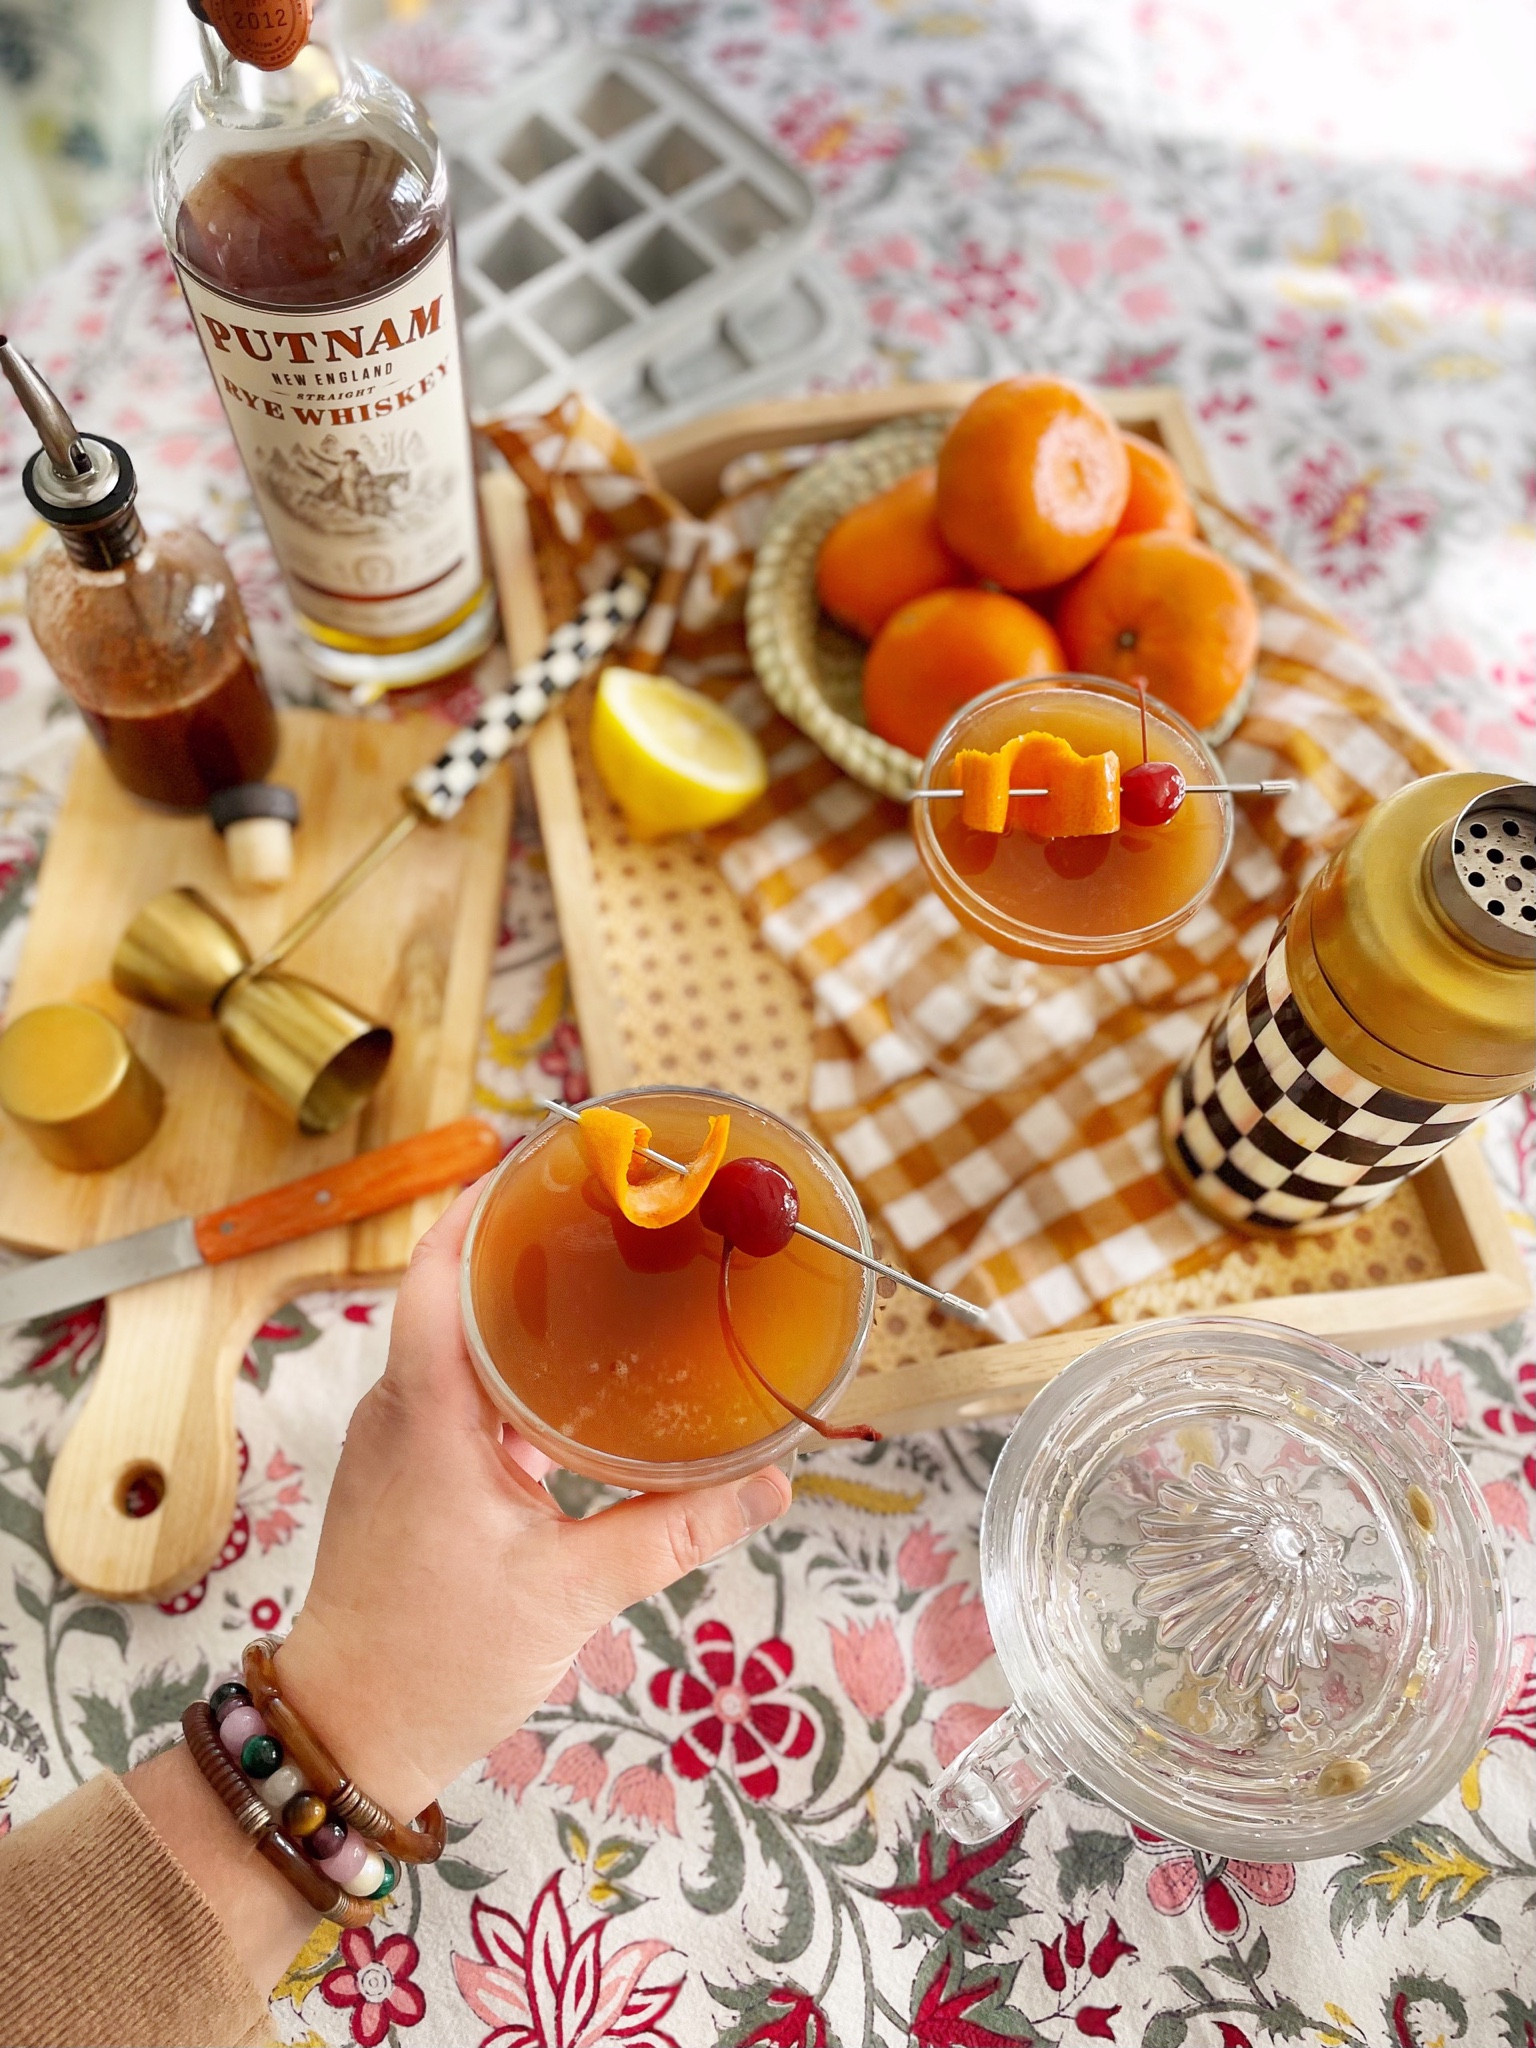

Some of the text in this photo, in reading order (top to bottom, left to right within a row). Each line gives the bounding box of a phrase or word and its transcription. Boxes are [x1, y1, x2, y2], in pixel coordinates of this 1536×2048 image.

[233, 8, 288, 30] 2012
[200, 294, 443, 364] PUTNAM
[271, 362, 394, 387] NEW ENGLAND
[222, 353, 450, 426] RYE WHISKEY
[296, 386, 377, 401] STRAIGHT
